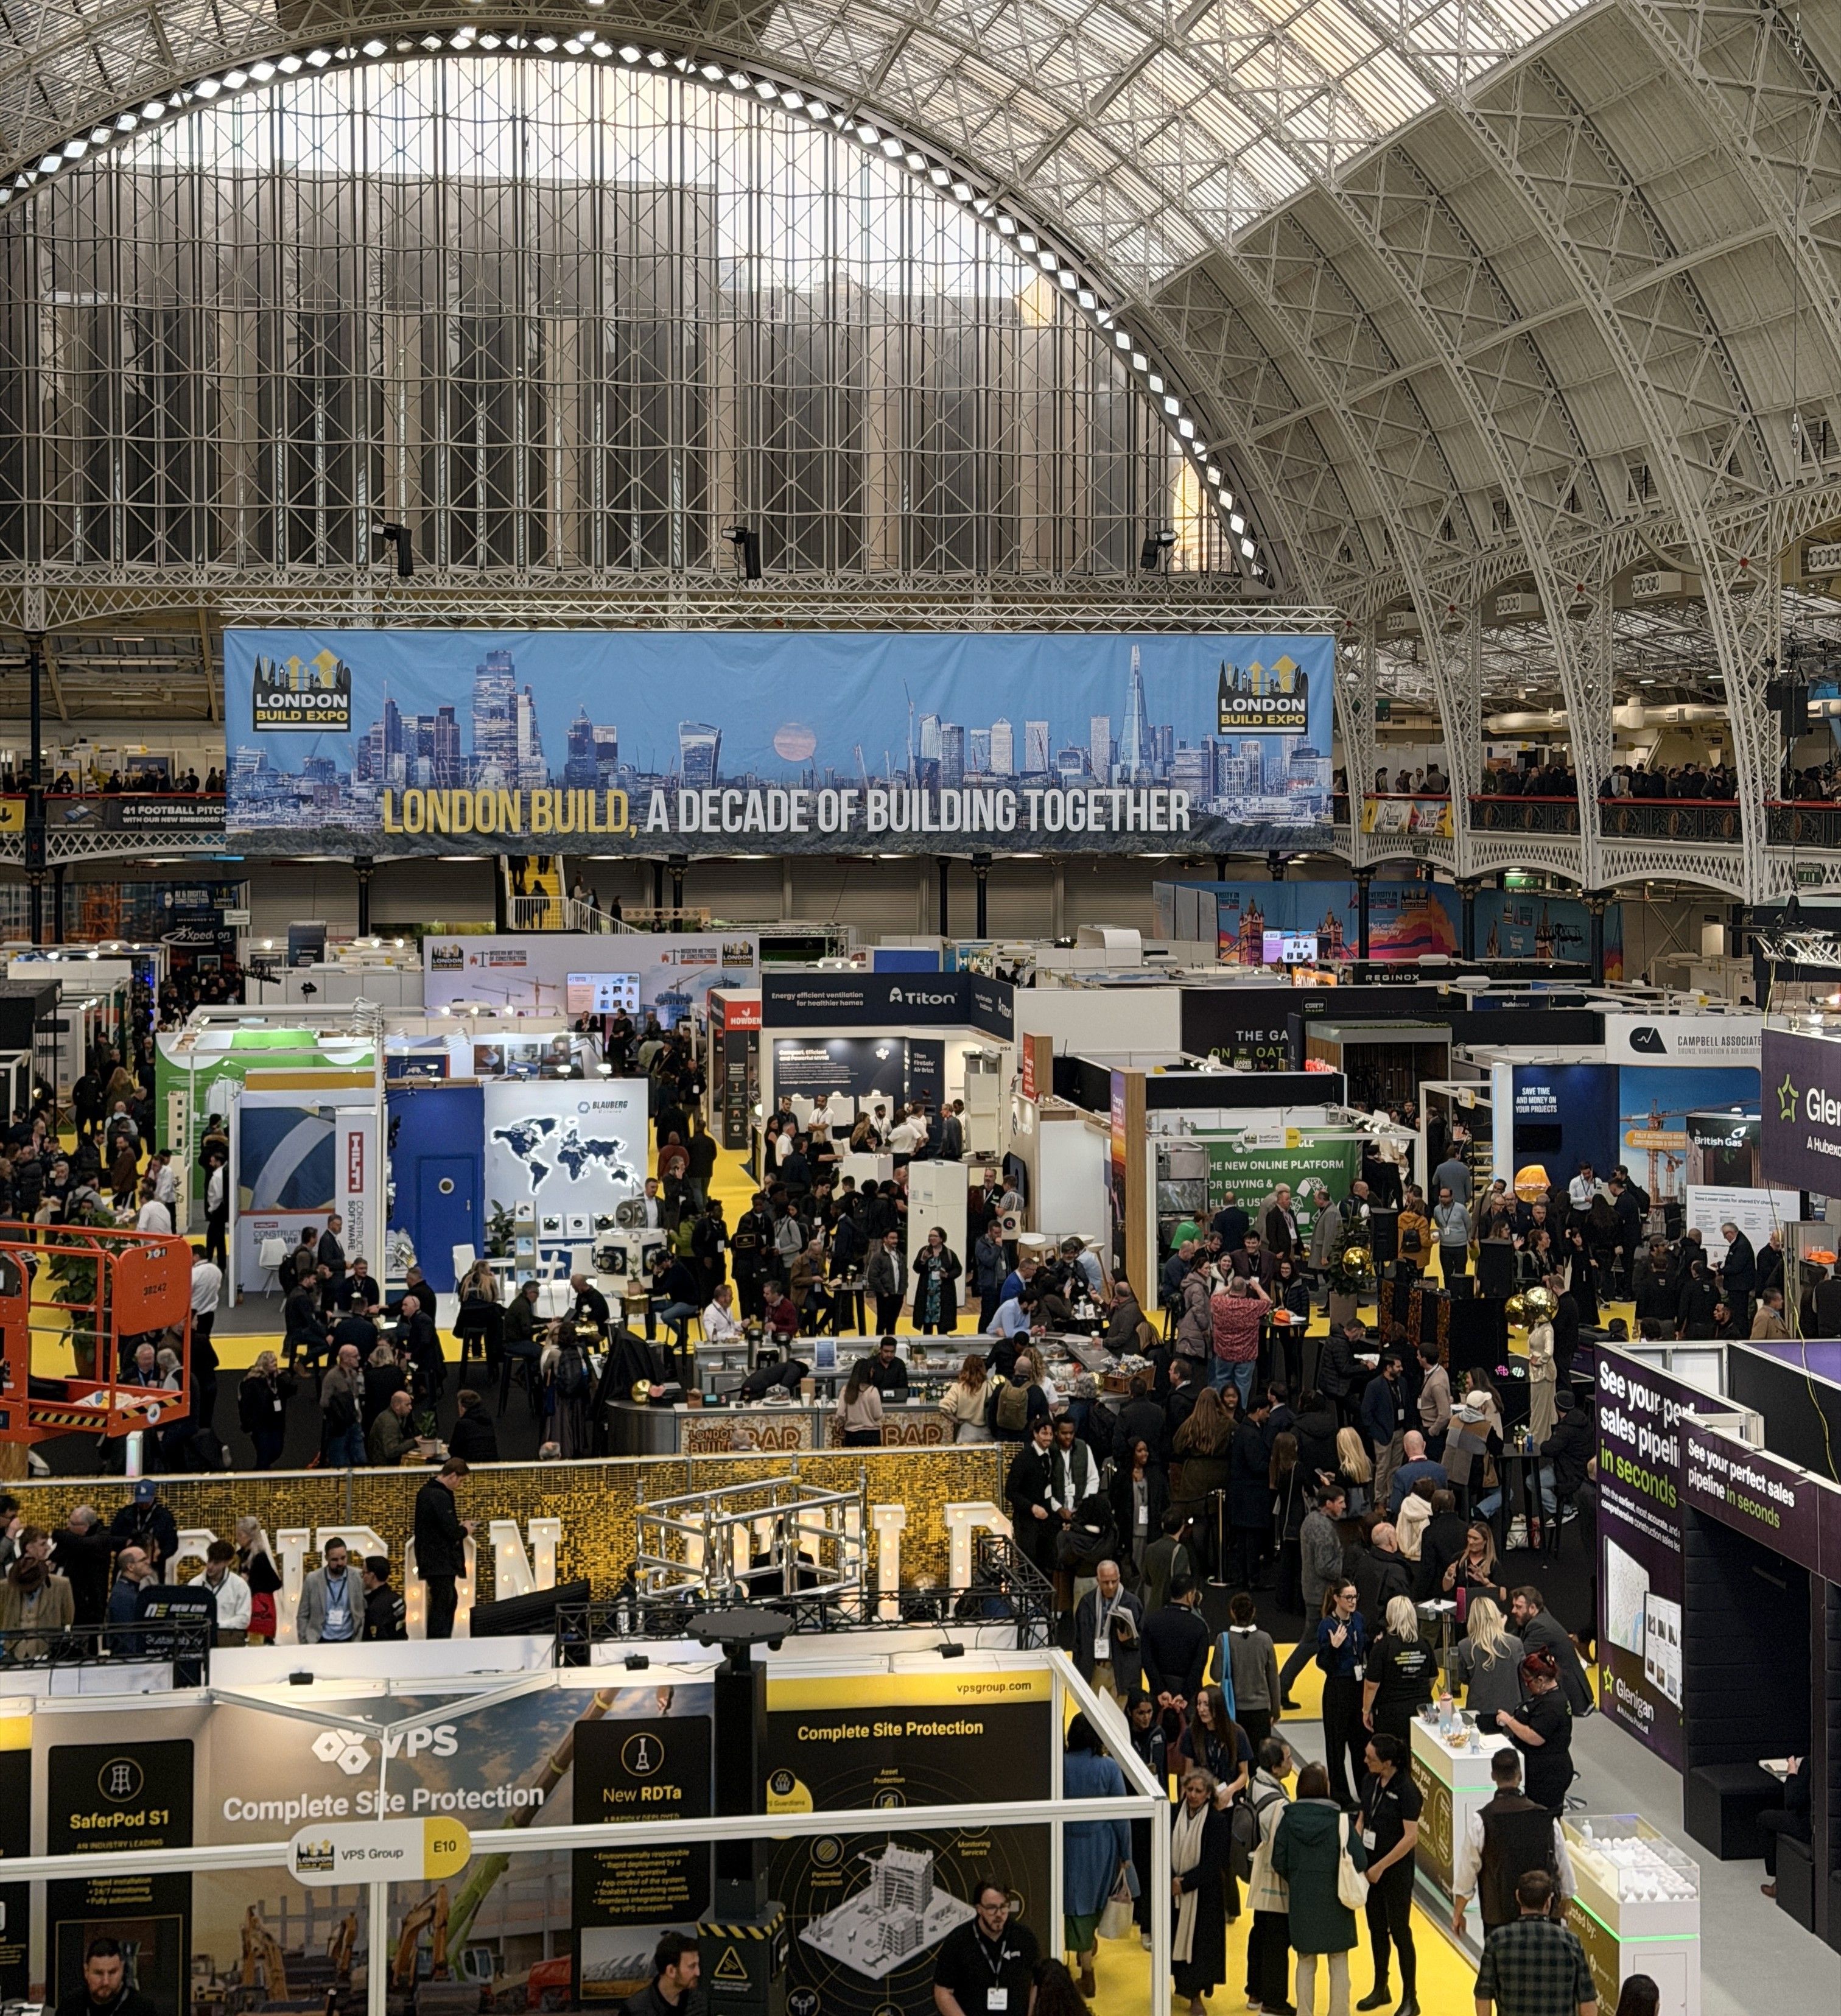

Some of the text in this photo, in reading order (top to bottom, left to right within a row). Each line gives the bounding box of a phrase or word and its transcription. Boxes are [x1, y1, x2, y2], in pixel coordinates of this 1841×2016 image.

[256, 694, 348, 708] LONDON
[1221, 698, 1305, 712] LONDON
[256, 711, 348, 721] BUILD EXPO
[1221, 715, 1305, 725] BUILD EXPO
[122, 806, 193, 815] 41 FOOTBALL
[384, 790, 1190, 838] LONDON BUILD, A DECADE OF BUILDING TOGETHER
[905, 992, 955, 1005] Titon
[1236, 1030, 1289, 1041] THE GA
[1678, 1036, 1719, 1046] CAMPBELL
[1211, 1047, 1230, 1058] ON
[1695, 1136, 1724, 1147] British
[1725, 1137, 1742, 1147] Gas
[1806, 1136, 1813, 1150] A
[351, 1136, 360, 1190] HILTI
[1210, 1160, 1344, 1170] HE NEW ONLINE PLATFORM
[1226, 1179, 1273, 1189] BUYING &
[1600, 1361, 1661, 1416] See your
[1601, 1407, 1636, 1445] sales
[883, 1425, 942, 1445] BAR
[1601, 1438, 1677, 1509] in seconds
[1688, 1438, 1796, 1508] See your perfect sales
[1688, 1466, 1781, 1530] pipeline in seconds
[1634, 1518, 1661, 1542] construction
[956, 1681, 1032, 1695] vpsgroup.com
[1616, 1677, 1654, 1722] Glenigan
[798, 1719, 984, 1743] Complete Site Protection
[603, 1785, 682, 1803] New RDTa
[223, 1783, 544, 1825] Complete Site Protection
[69, 1809, 169, 1829] SaferPod S1
[89, 1840, 128, 1850] INDUSTRY
[129, 1838, 164, 1849] LEADING
[342, 1840, 457, 1860] VPS Group E10
[958, 1840, 991, 1849] Monitoring
[628, 1860, 665, 1869] deployment
[617, 1878, 640, 1886] control
